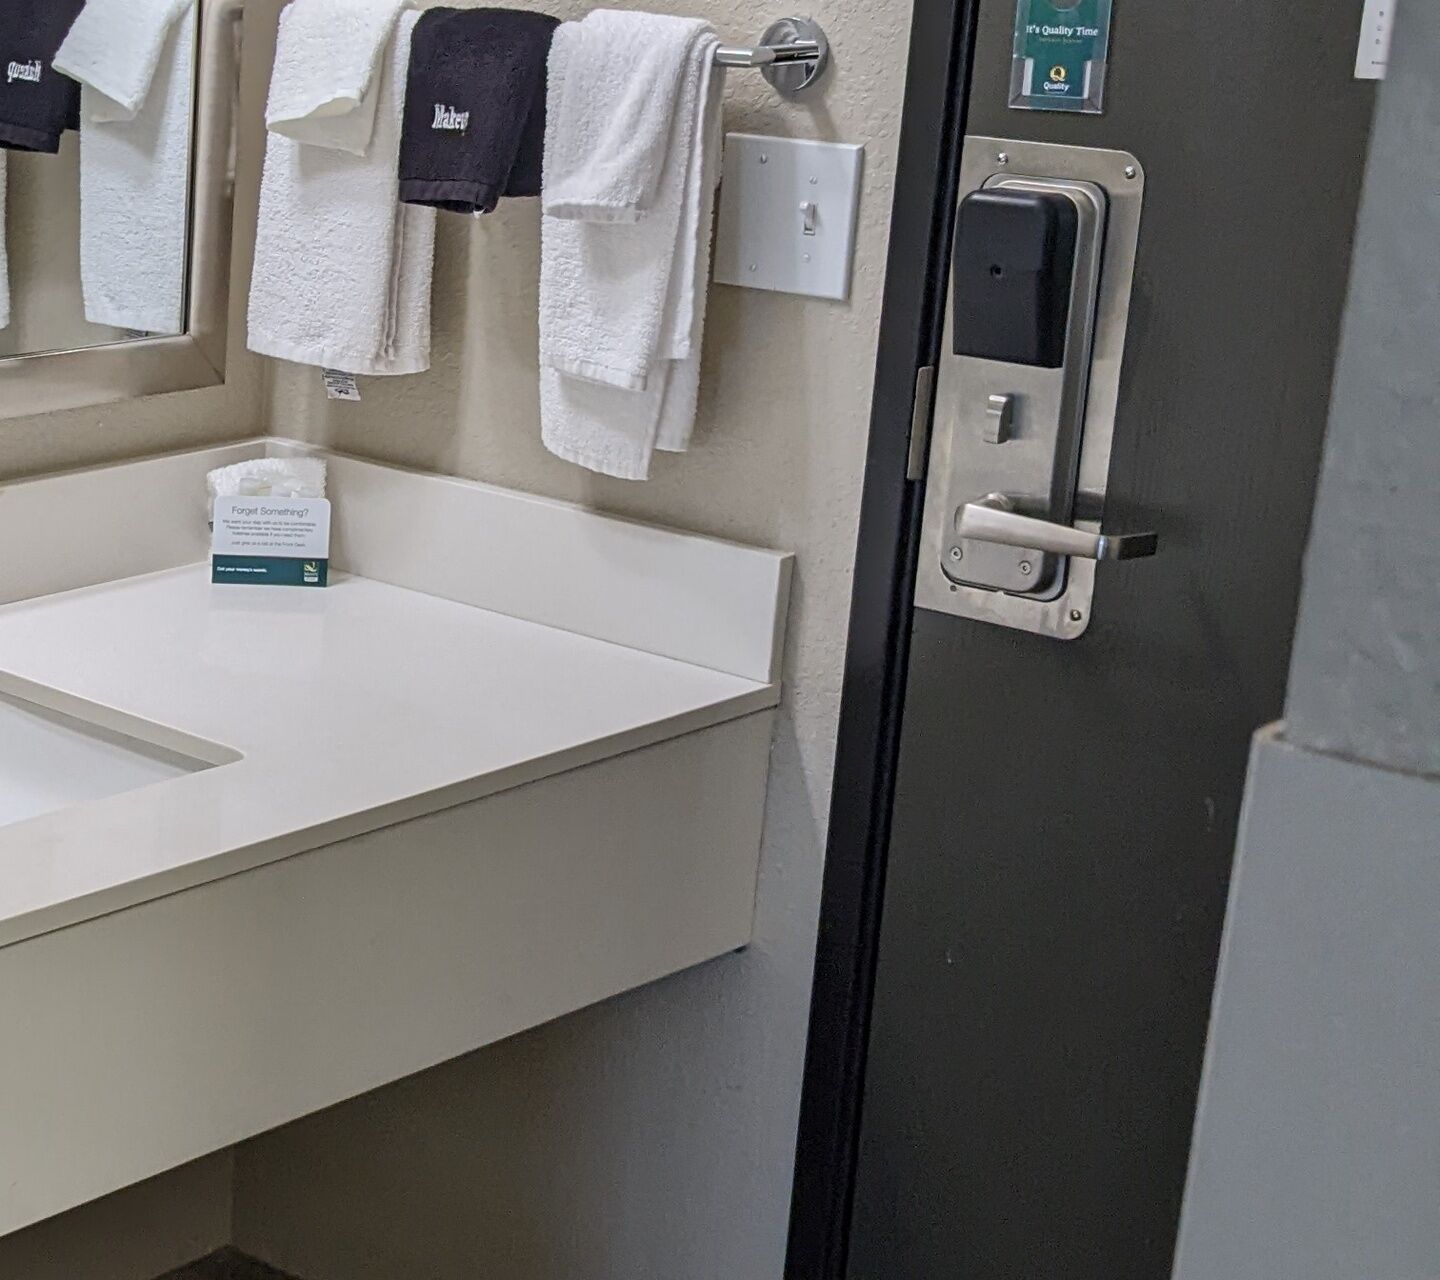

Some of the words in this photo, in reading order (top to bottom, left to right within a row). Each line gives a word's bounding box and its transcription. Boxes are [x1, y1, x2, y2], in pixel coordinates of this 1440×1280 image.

[1026, 25, 1040, 34] It's
[1042, 25, 1074, 37] Quality
[1076, 26, 1099, 36] Time
[1043, 81, 1070, 92] Quality
[231, 506, 258, 517] Forget
[260, 506, 309, 519] Something?
